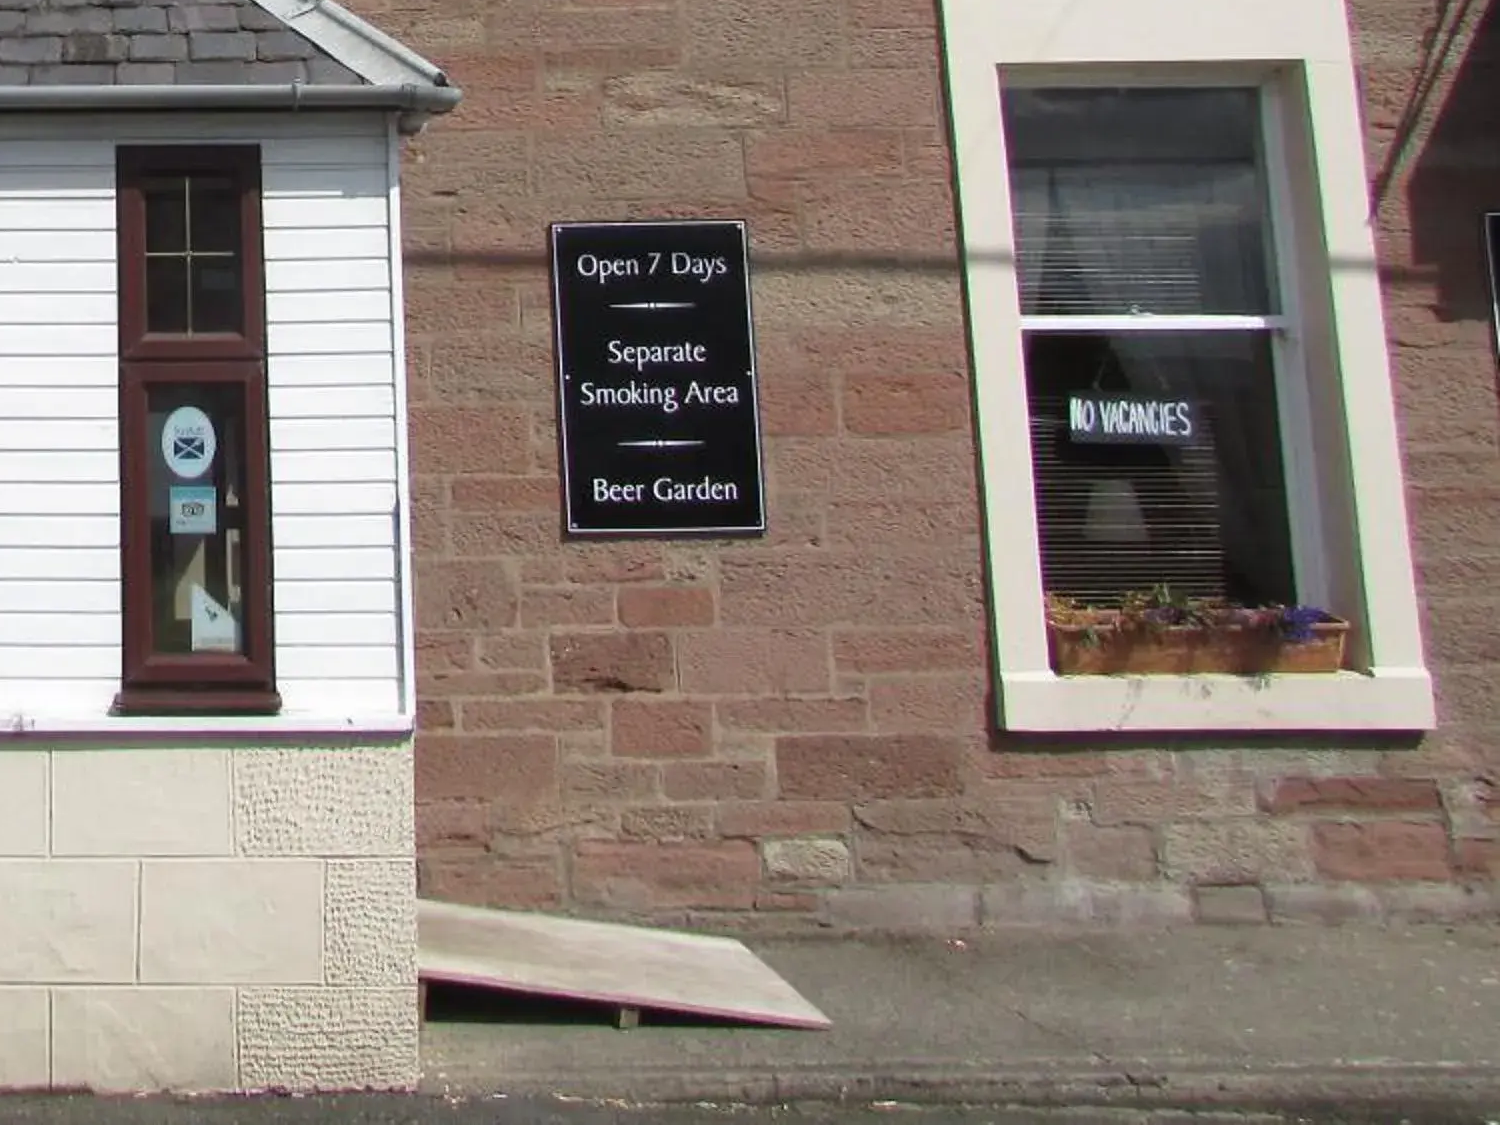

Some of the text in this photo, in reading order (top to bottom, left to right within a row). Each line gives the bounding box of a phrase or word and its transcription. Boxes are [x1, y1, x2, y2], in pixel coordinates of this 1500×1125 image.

[577, 253, 727, 283] Open 7 Days
[607, 340, 707, 371] Separate
[580, 382, 740, 413] Smoking Area
[1069, 397, 1192, 437] NO VACANCIES
[593, 478, 739, 502] Beer Garden
